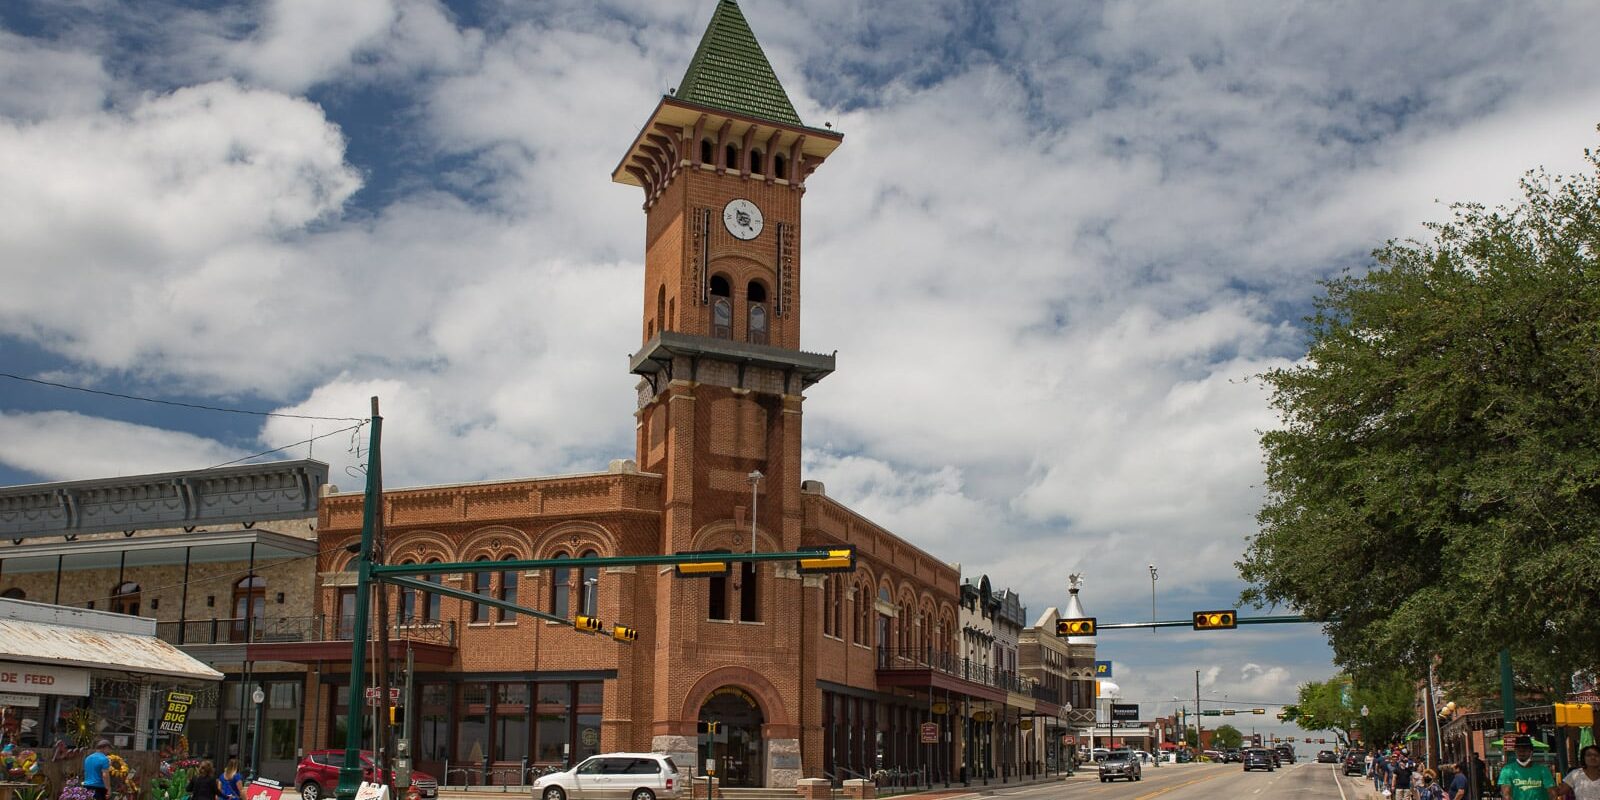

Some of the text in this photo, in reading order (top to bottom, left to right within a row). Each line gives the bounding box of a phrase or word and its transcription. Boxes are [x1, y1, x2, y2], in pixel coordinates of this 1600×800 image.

[24, 674, 55, 685] FEED
[168, 703, 188, 713] BED
[164, 713, 185, 722] BUG
[160, 721, 183, 732] KILLER
